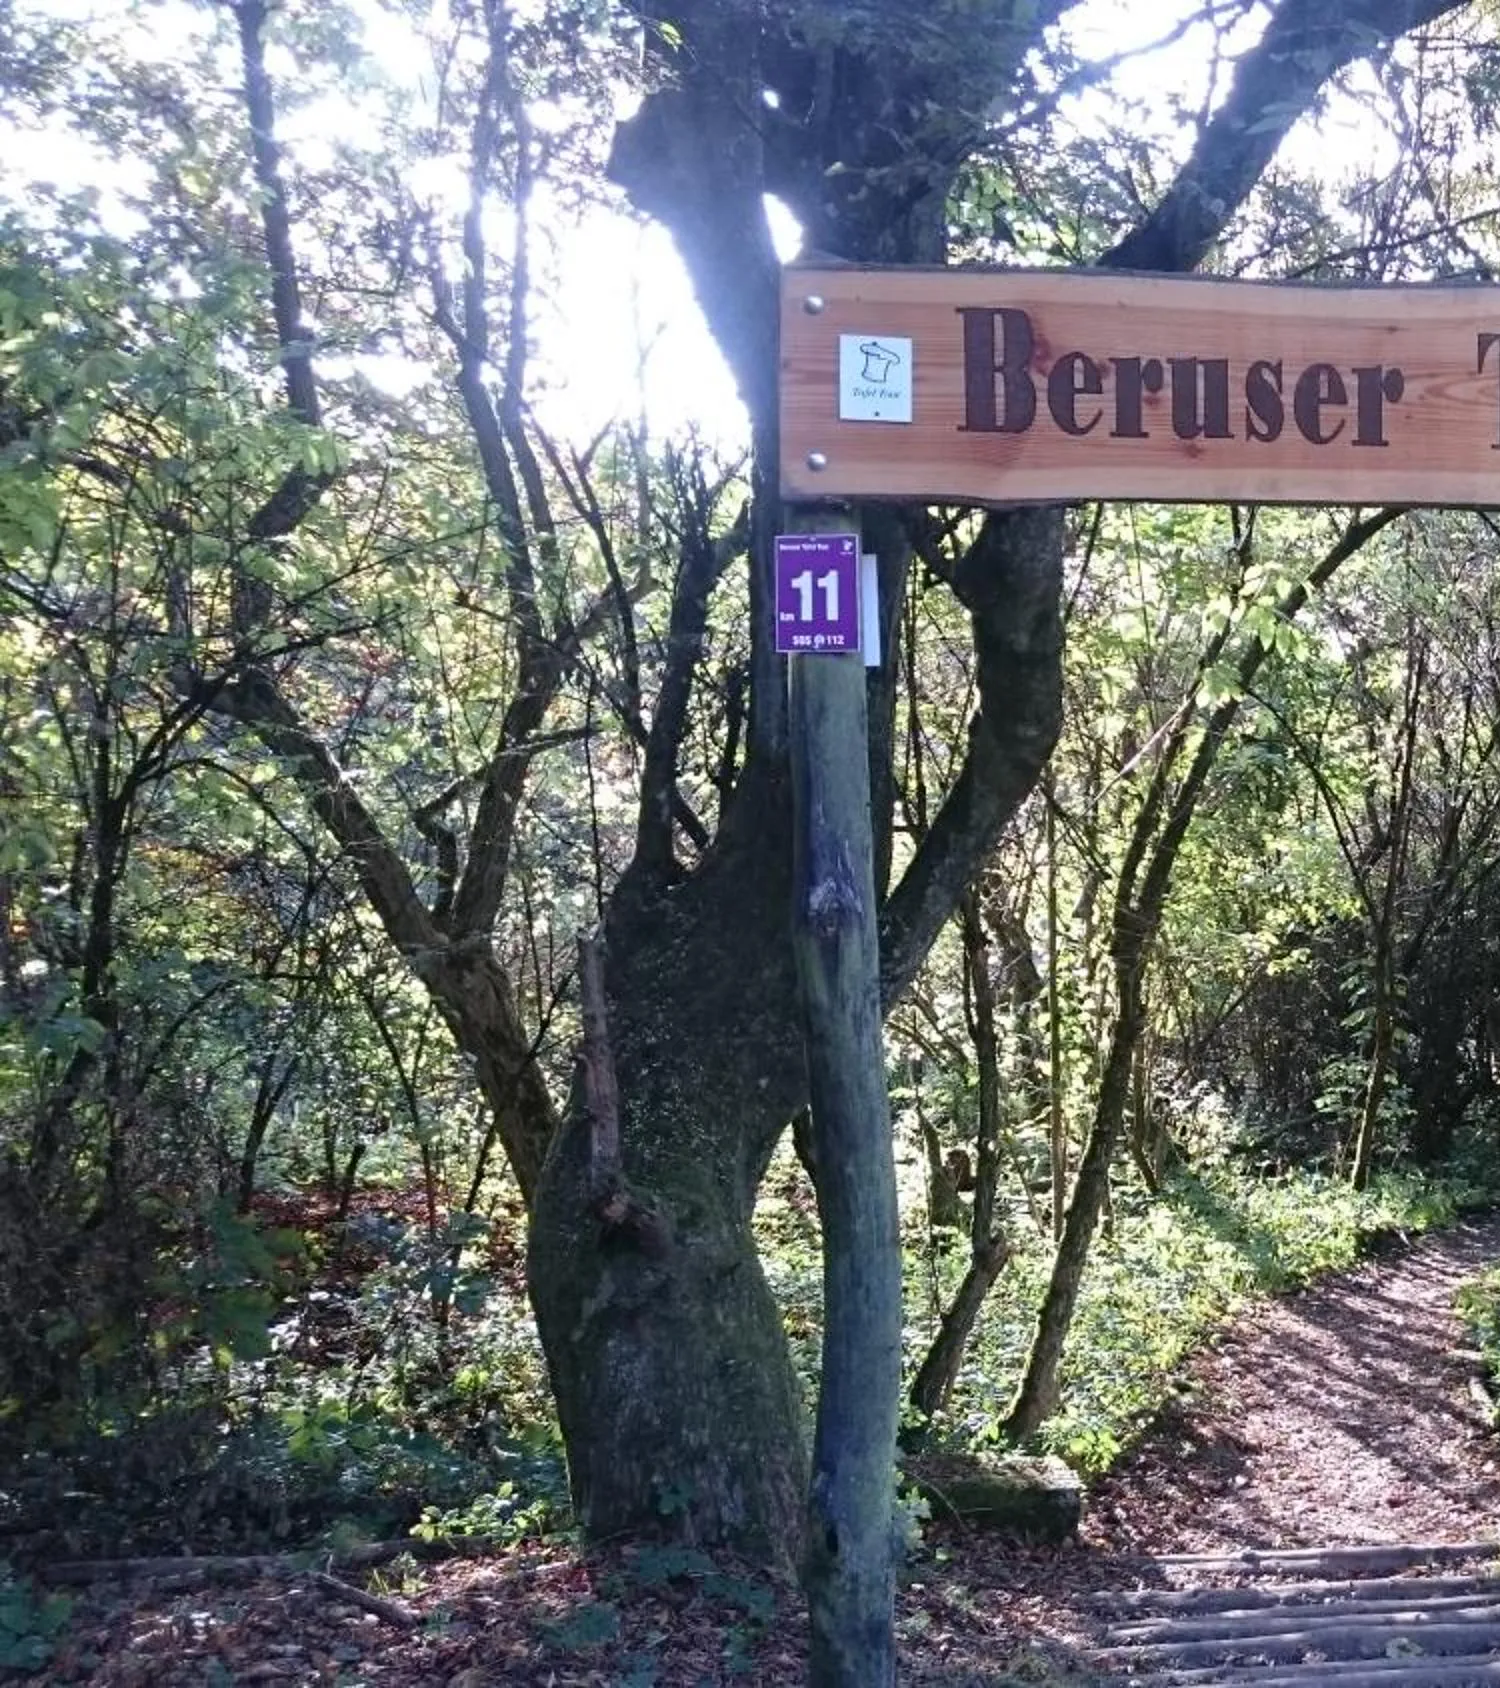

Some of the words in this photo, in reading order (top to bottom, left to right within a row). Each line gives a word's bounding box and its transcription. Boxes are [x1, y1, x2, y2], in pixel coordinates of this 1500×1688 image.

[955, 307, 1405, 446] Beruser
[791, 570, 839, 621] 11
[827, 635, 845, 645] 112
